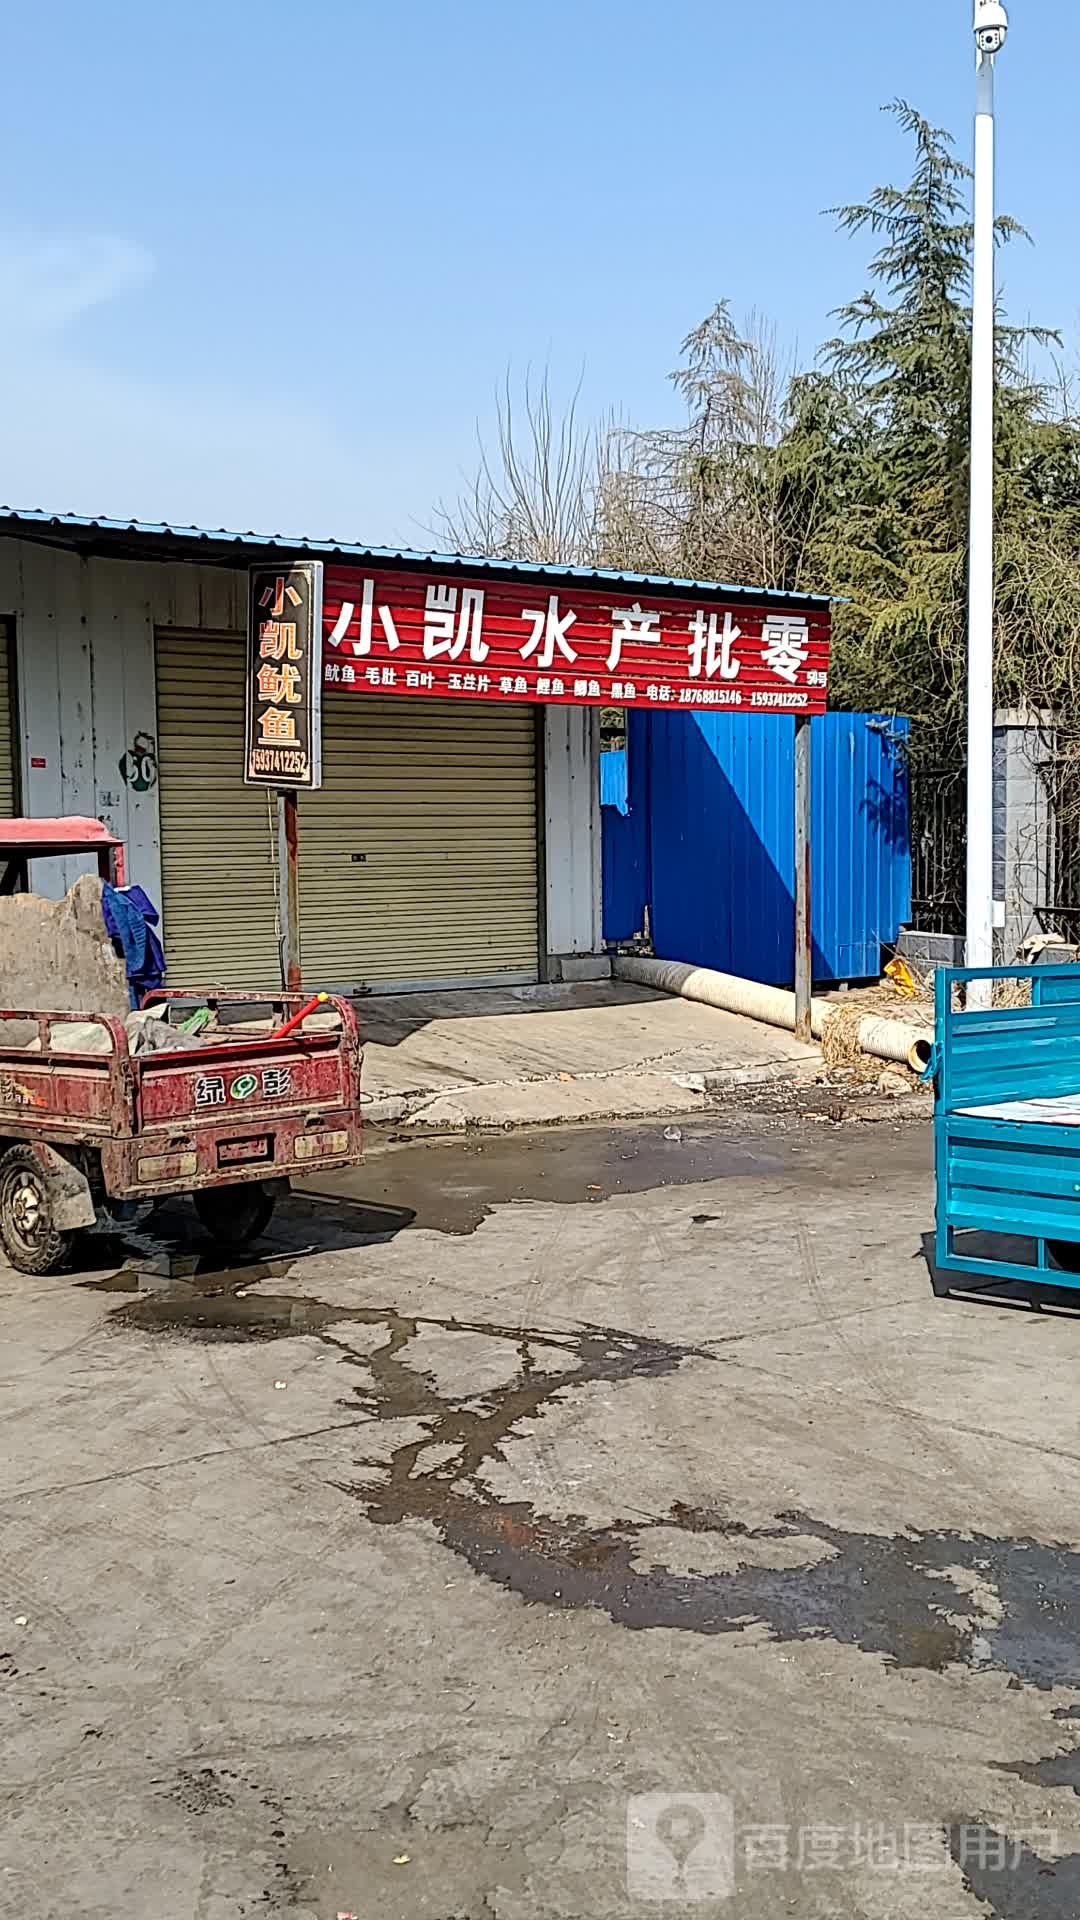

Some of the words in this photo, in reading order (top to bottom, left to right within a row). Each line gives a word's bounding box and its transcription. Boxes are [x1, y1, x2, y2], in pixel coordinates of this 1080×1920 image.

[258, 577, 302, 746] 小凯鱿鱼
[328, 579, 808, 683] 小凯水产批零
[324, 664, 355, 683] 鱿鱼
[365, 667, 396, 685] 毛肚
[405, 670, 435, 689] 百叶
[447, 673, 491, 692] 玉兰片
[499, 676, 528, 694] 草鱼
[536, 677, 565, 695] 鲤鱼
[611, 682, 636, 699] 黑鱼
[679, 688, 742, 704] 18768815146
[750, 692, 808, 707] 15937412252
